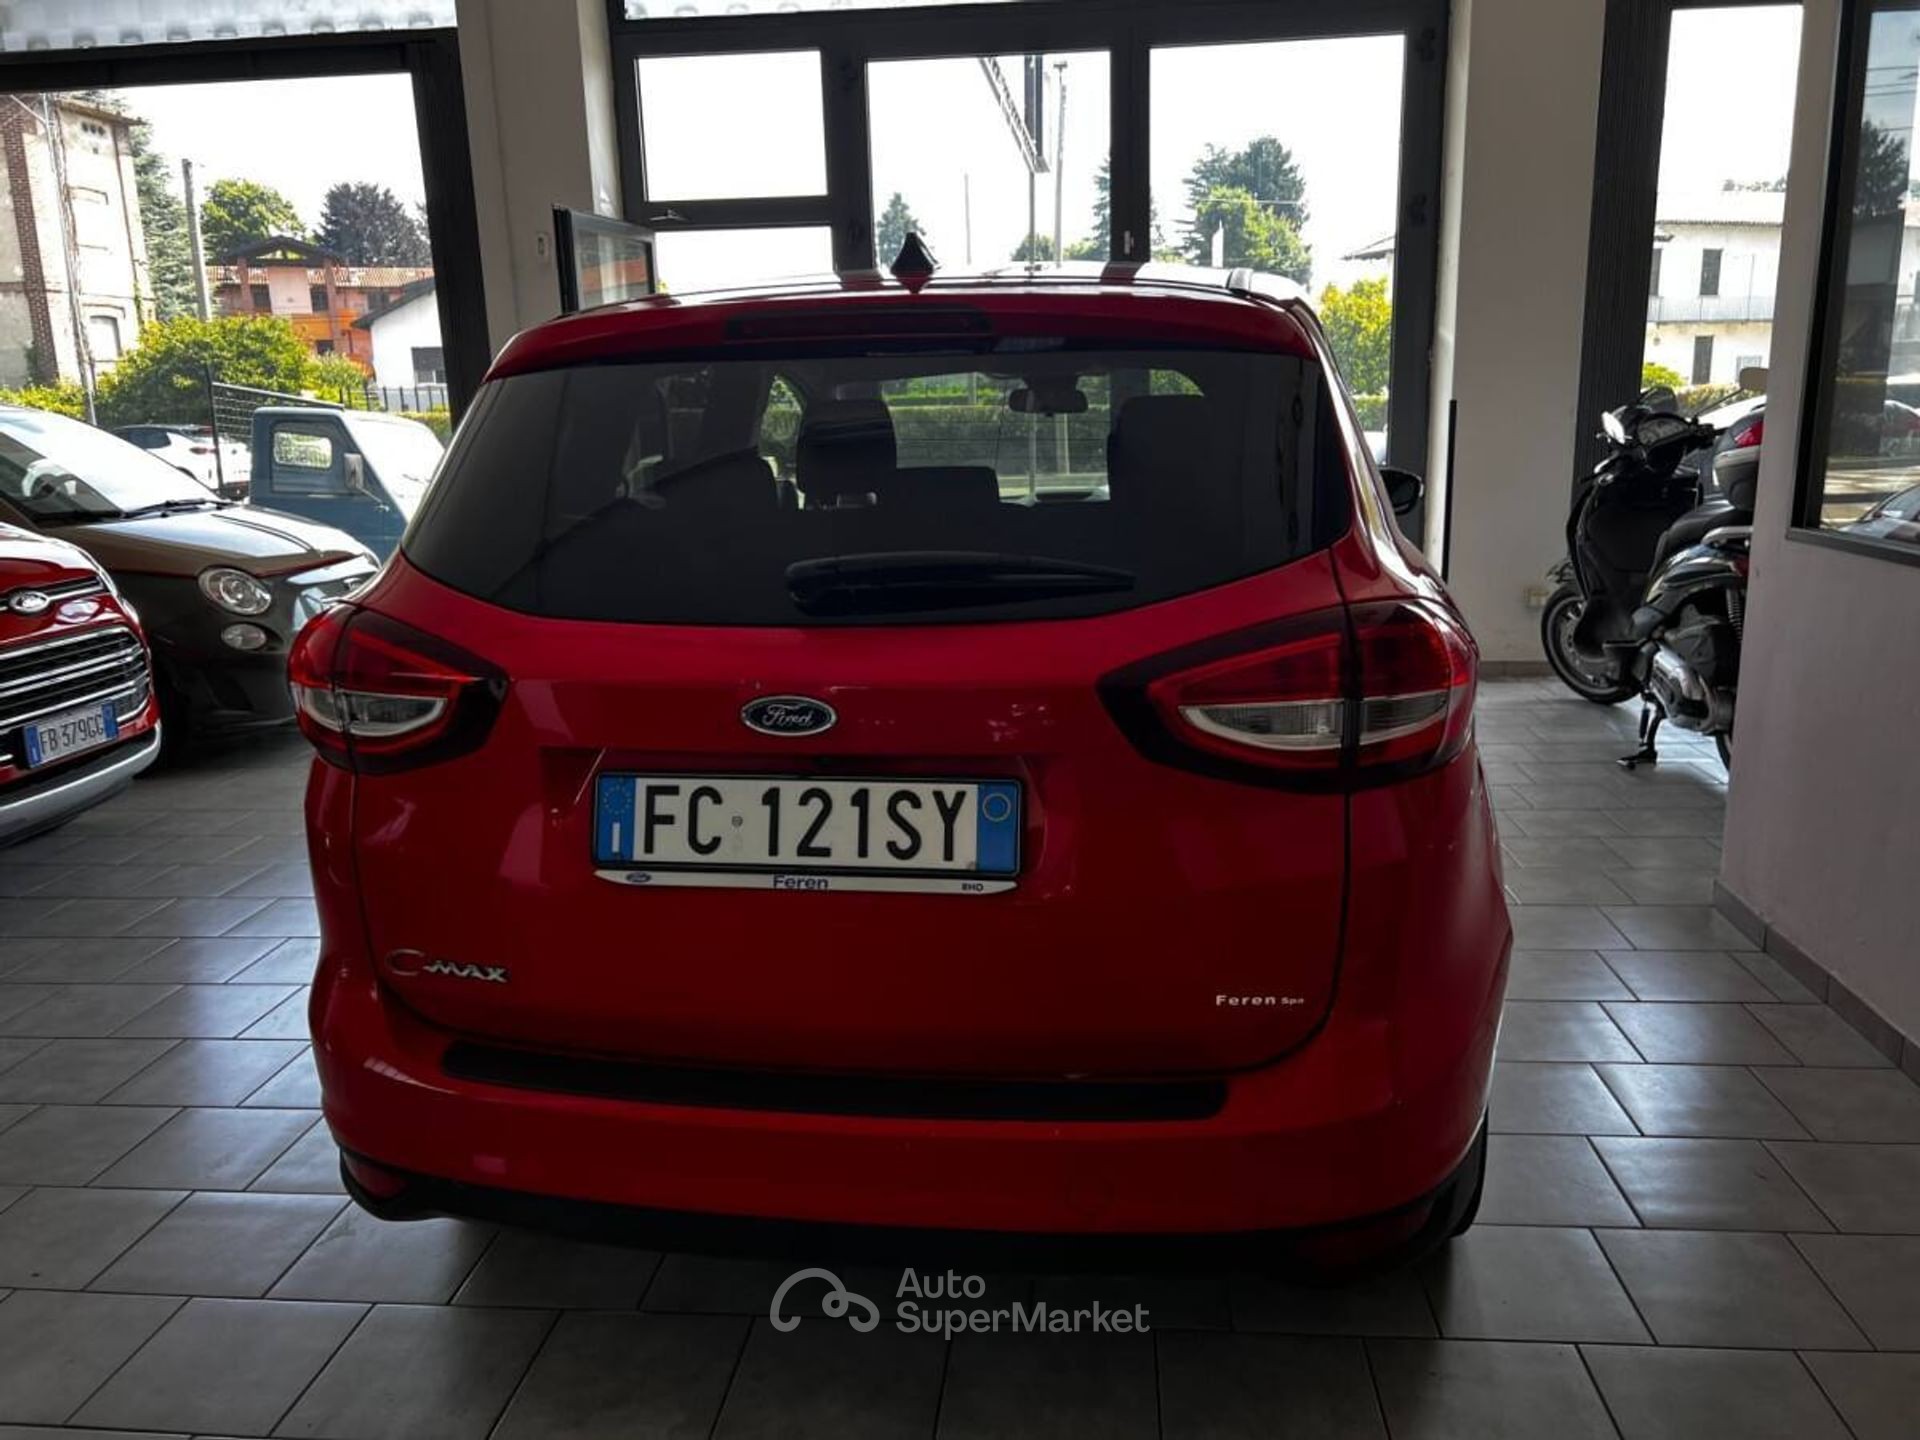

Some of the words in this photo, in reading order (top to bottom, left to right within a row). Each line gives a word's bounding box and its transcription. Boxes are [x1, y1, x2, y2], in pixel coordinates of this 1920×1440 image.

[763, 703, 815, 726] Ford
[40, 728, 58, 755] FB
[61, 714, 104, 746] 379GG
[643, 785, 724, 855] FC
[761, 786, 967, 862] 121SY
[773, 874, 829, 890] Feren
[1215, 994, 1276, 1006] Feren
